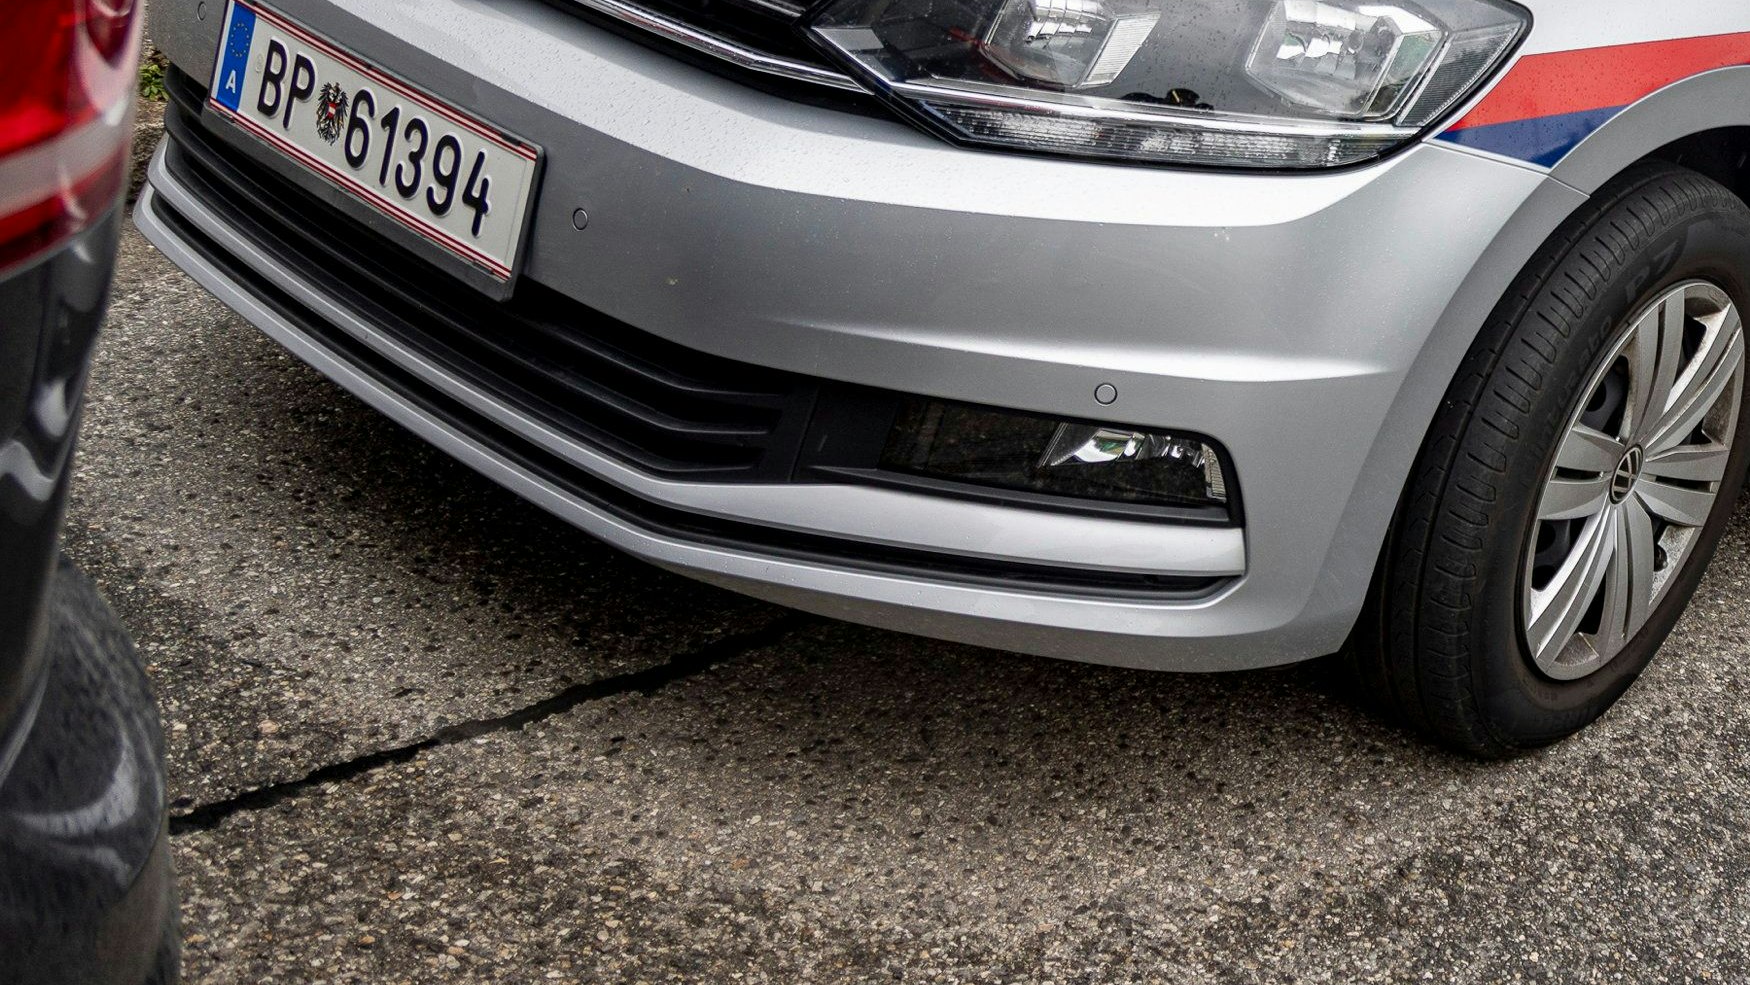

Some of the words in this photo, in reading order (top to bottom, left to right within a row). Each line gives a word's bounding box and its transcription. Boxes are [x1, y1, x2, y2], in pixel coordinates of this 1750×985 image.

[225, 69, 236, 95] A
[256, 38, 317, 130] BP
[344, 88, 490, 238] 61394
